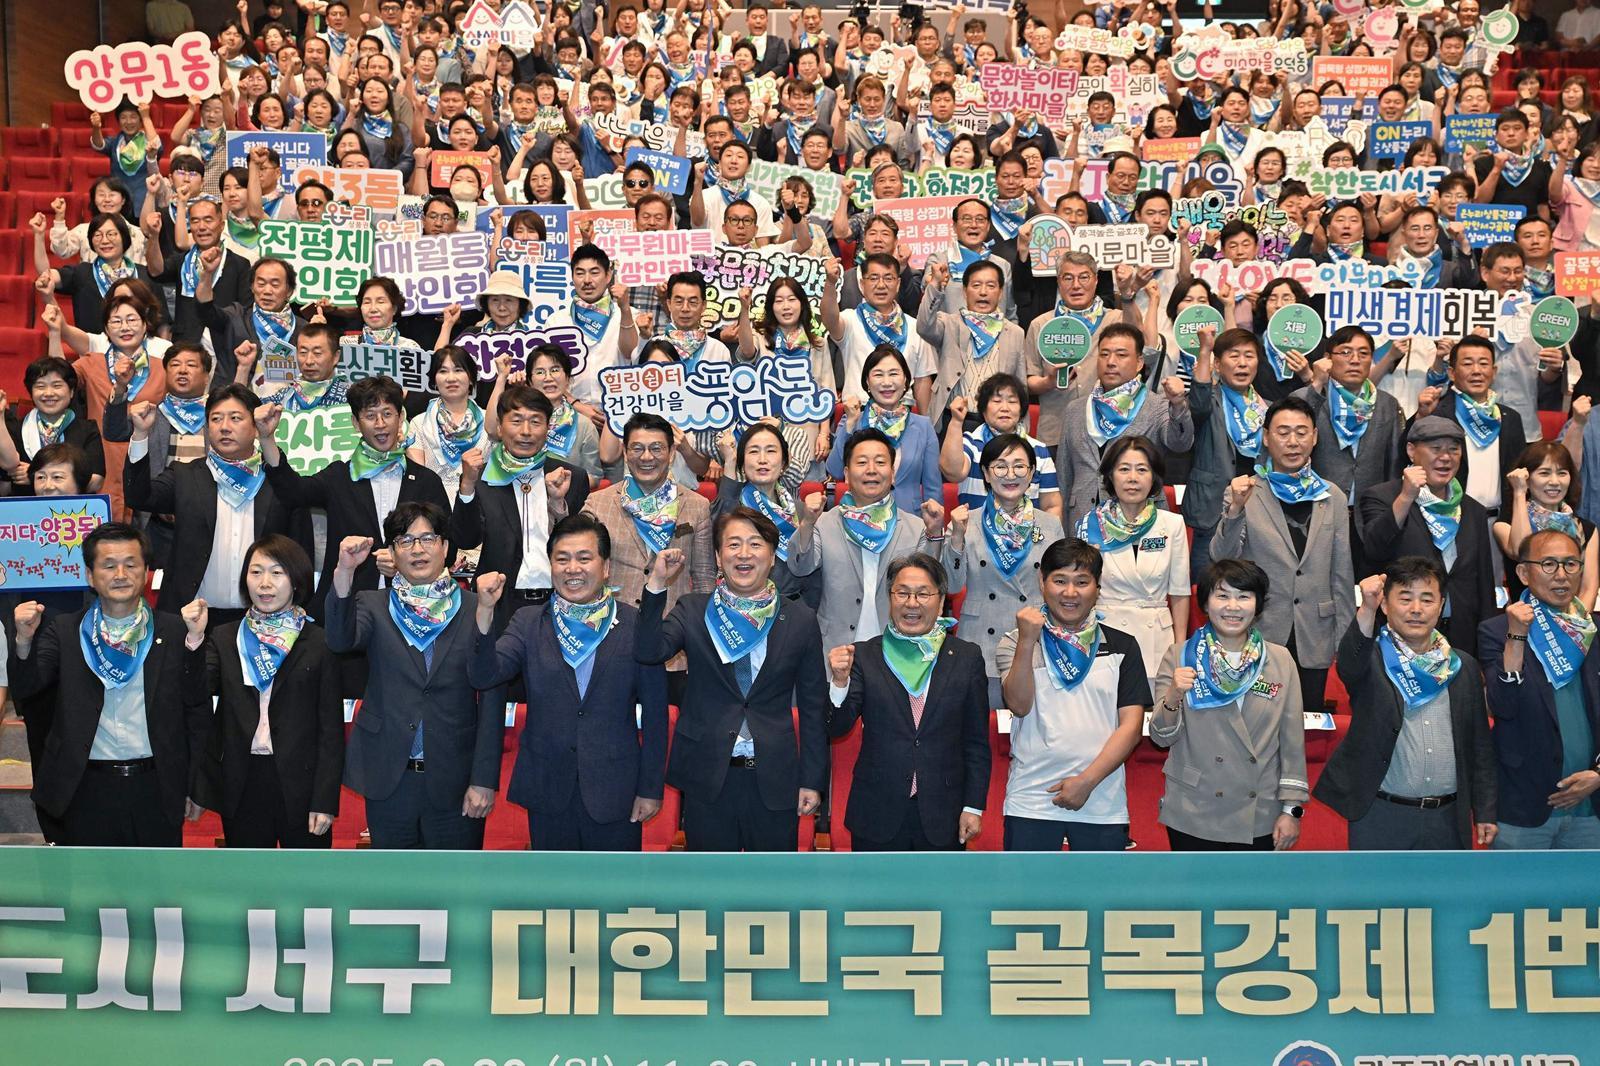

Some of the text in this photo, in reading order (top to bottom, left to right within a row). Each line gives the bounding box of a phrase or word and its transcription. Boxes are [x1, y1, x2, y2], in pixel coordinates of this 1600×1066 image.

[74, 41, 210, 103] 상무1동
[982, 65, 1077, 92] 문화놀이터
[989, 91, 1065, 116] 화사마을
[260, 224, 370, 264] 전평제
[378, 234, 485, 274] 매월동
[594, 231, 713, 260] 상무원마륵
[1329, 290, 1497, 338] 민생경제회복
[1538, 312, 1572, 327] GREEN
[1044, 333, 1086, 346] 감탄마을
[604, 355, 836, 432] 힐링쉼터 풍암동
[608, 391, 685, 417] 건강마을
[557, 633, 577, 656] 2025년
[567, 633, 583, 651] 서구
[719, 625, 737, 649] 2025년
[731, 629, 744, 645] 서구
[1055, 658, 1074, 680] 2025년
[1066, 661, 1079, 676] 서구
[1545, 650, 1563, 676] 2025년
[1558, 655, 1573, 673] 서구
[1193, 678, 1202, 698] 2025
[1202, 681, 1212, 697] 서구
[1395, 672, 1417, 697] 2025년
[1408, 678, 1424, 694] 서구
[226, 908, 452, 1014] 서구
[491, 907, 944, 1016] 대한민국
[987, 907, 1435, 1016] 골목경제
